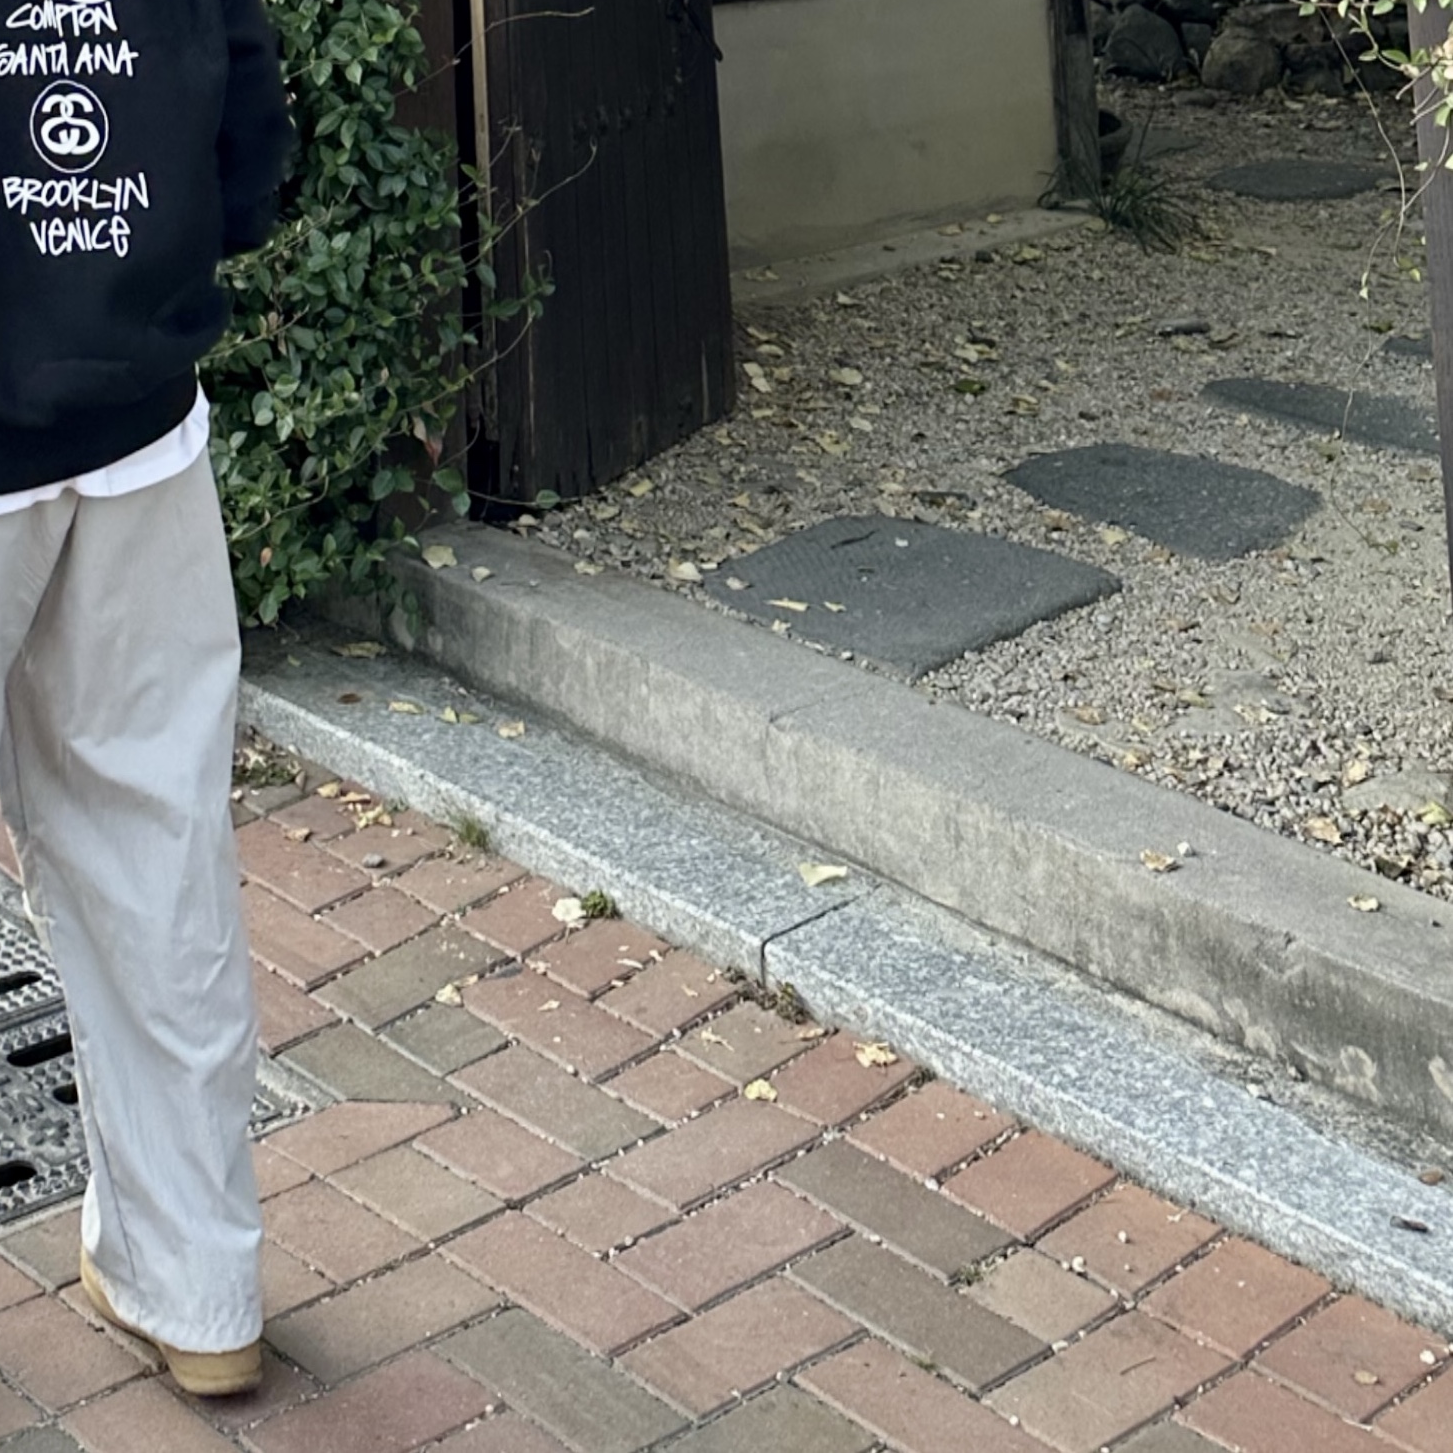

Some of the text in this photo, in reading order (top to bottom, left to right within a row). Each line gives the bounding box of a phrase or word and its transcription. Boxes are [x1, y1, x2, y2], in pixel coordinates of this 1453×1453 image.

[5, 0, 119, 38] COMPTON
[73, 40, 140, 78] ANA
[2, 171, 150, 215] BROOKLYN
